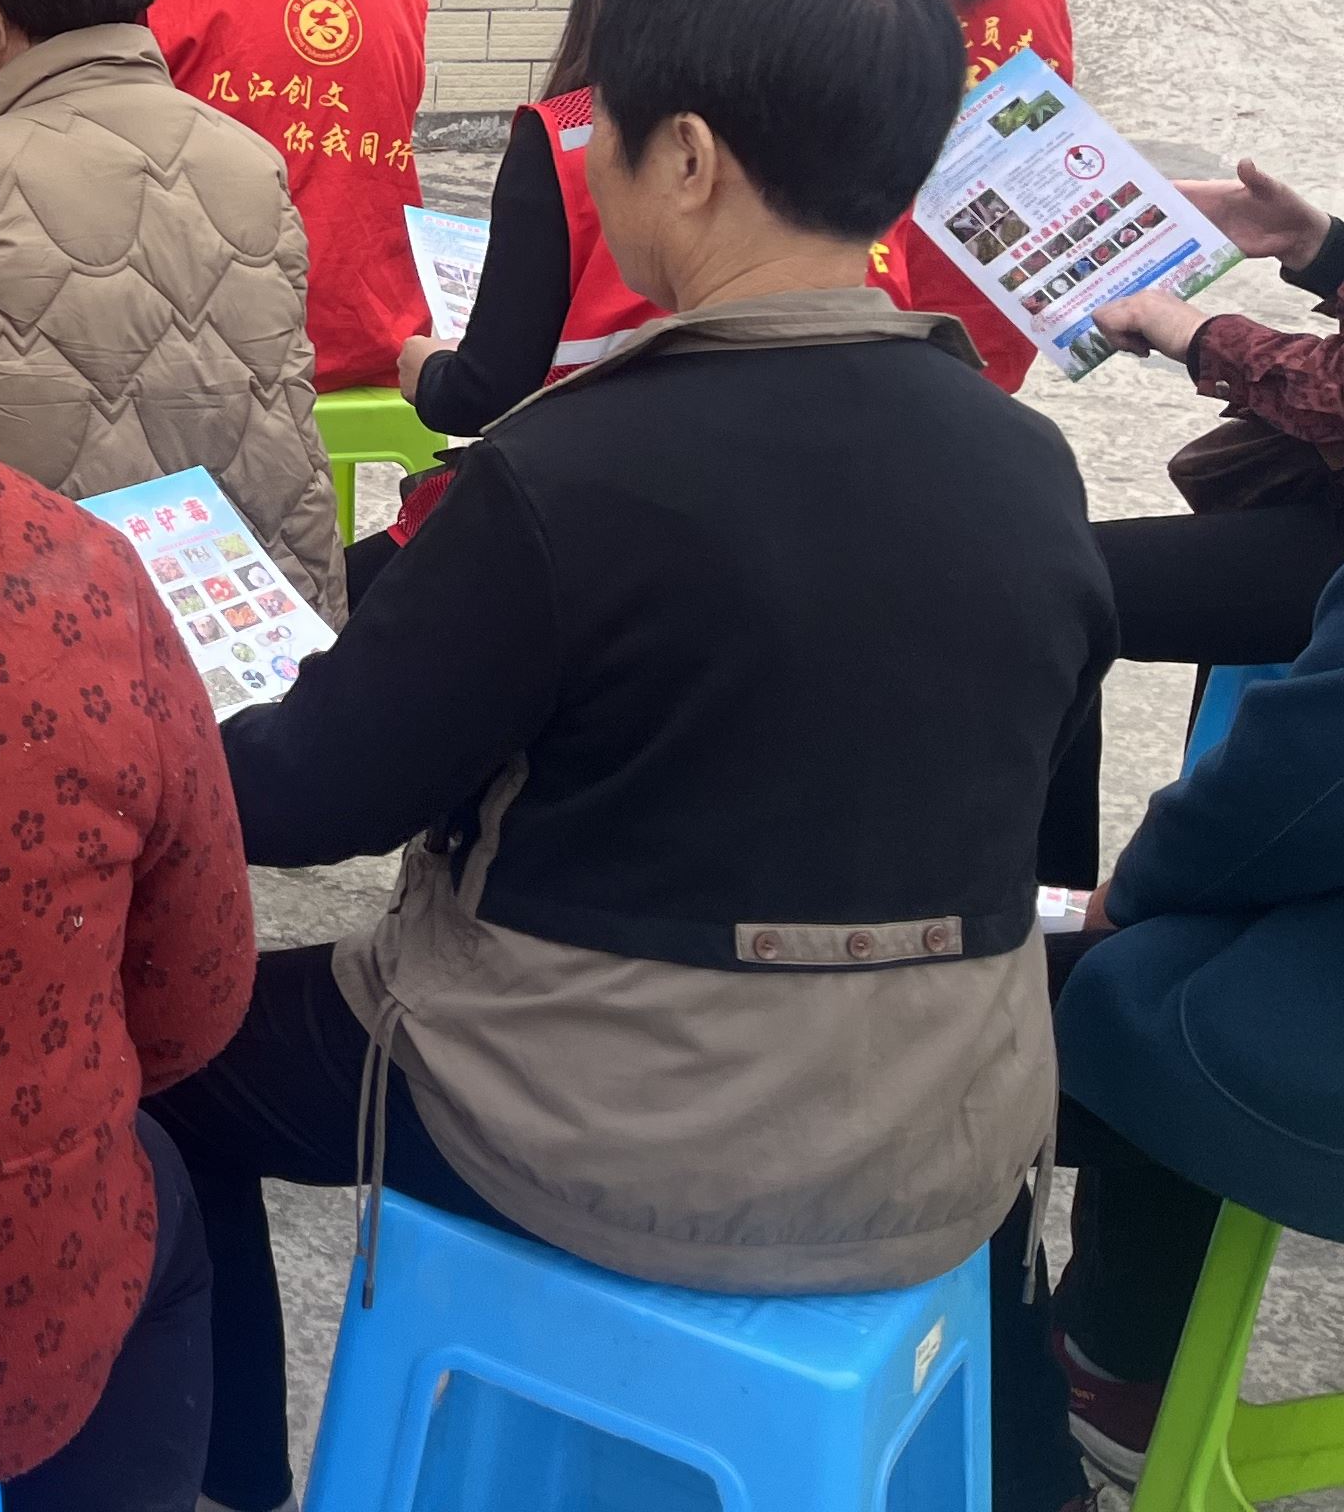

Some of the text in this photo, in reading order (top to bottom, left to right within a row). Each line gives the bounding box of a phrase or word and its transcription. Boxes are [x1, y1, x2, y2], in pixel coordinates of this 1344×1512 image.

[959, 16, 1060, 72] 员志
[207, 70, 349, 112] 几江创文
[283, 121, 414, 172] 你我同行
